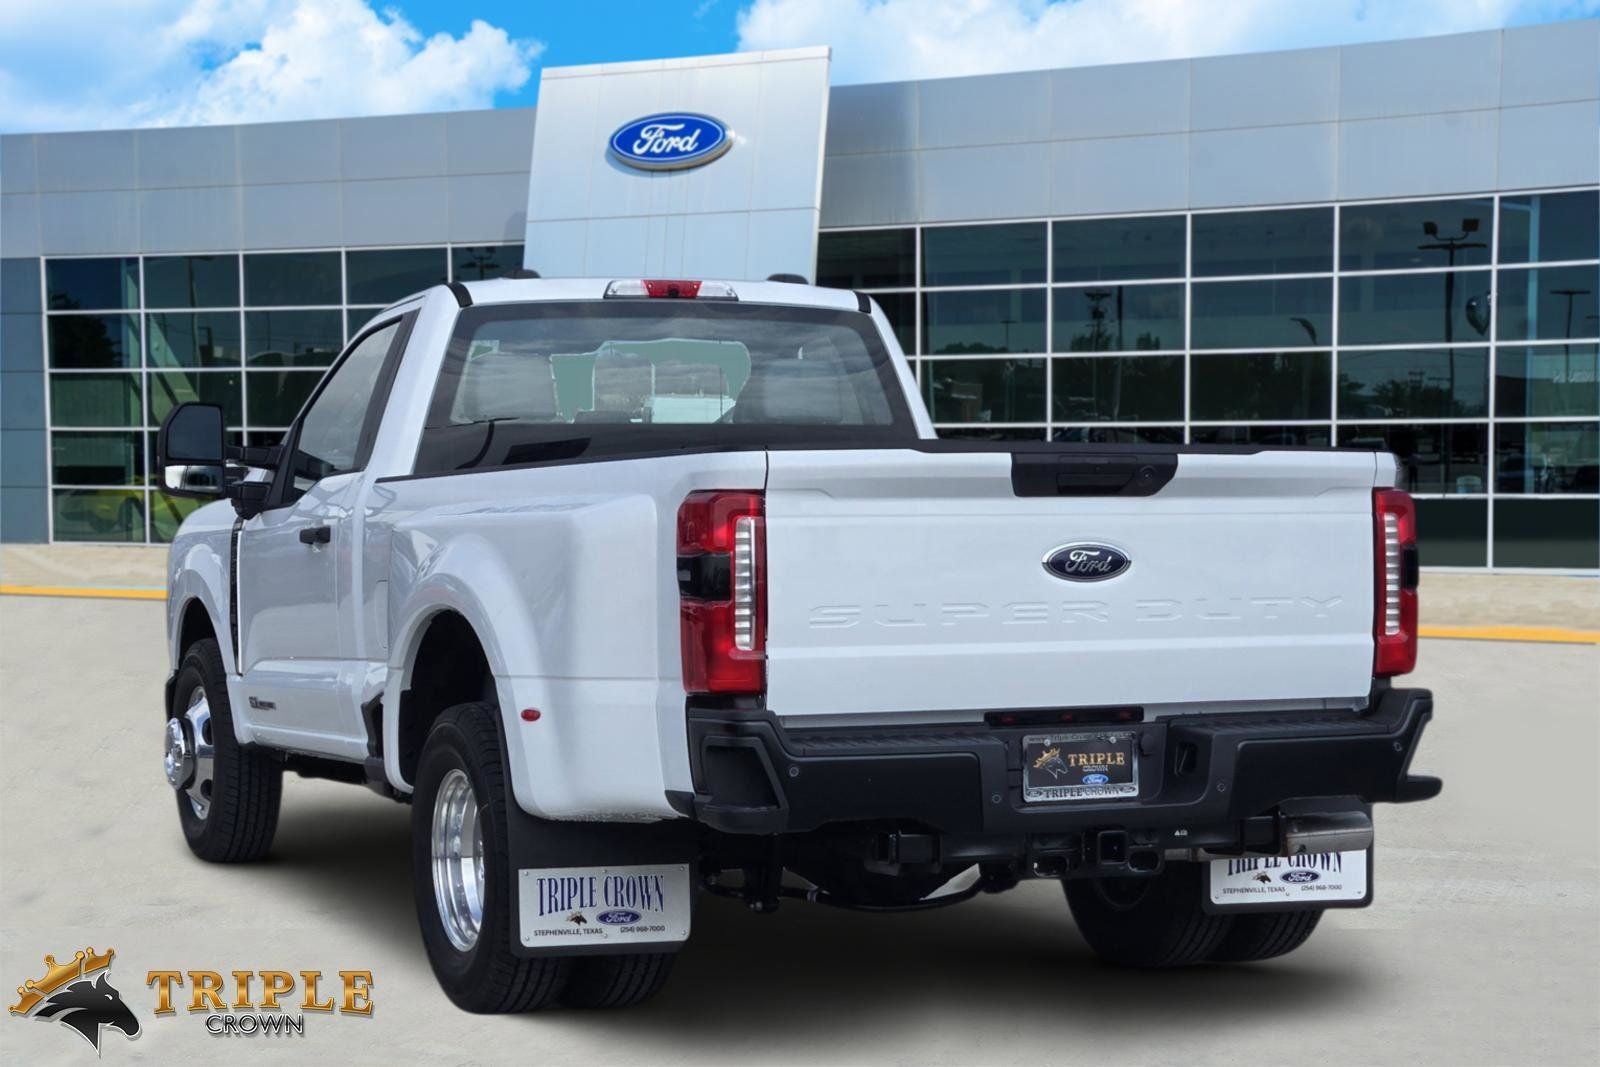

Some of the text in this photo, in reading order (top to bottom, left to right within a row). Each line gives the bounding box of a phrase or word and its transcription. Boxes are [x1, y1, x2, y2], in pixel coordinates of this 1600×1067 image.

[632, 123, 701, 155] Ford
[1065, 549, 1112, 572] Ford
[809, 595, 1343, 629] SUPER DUTY
[1068, 752, 1125, 767] TRIPLE
[1082, 764, 1108, 772] CROWN
[1045, 787, 1083, 798] TRIPLE
[1085, 785, 1120, 796] CROWN
[537, 875, 665, 917] TRIPLE CROWN
[1223, 887, 1267, 895] STEPHENVILLE,
[605, 912, 634, 924] Ford
[534, 929, 582, 937] STEPHENVILLE,
